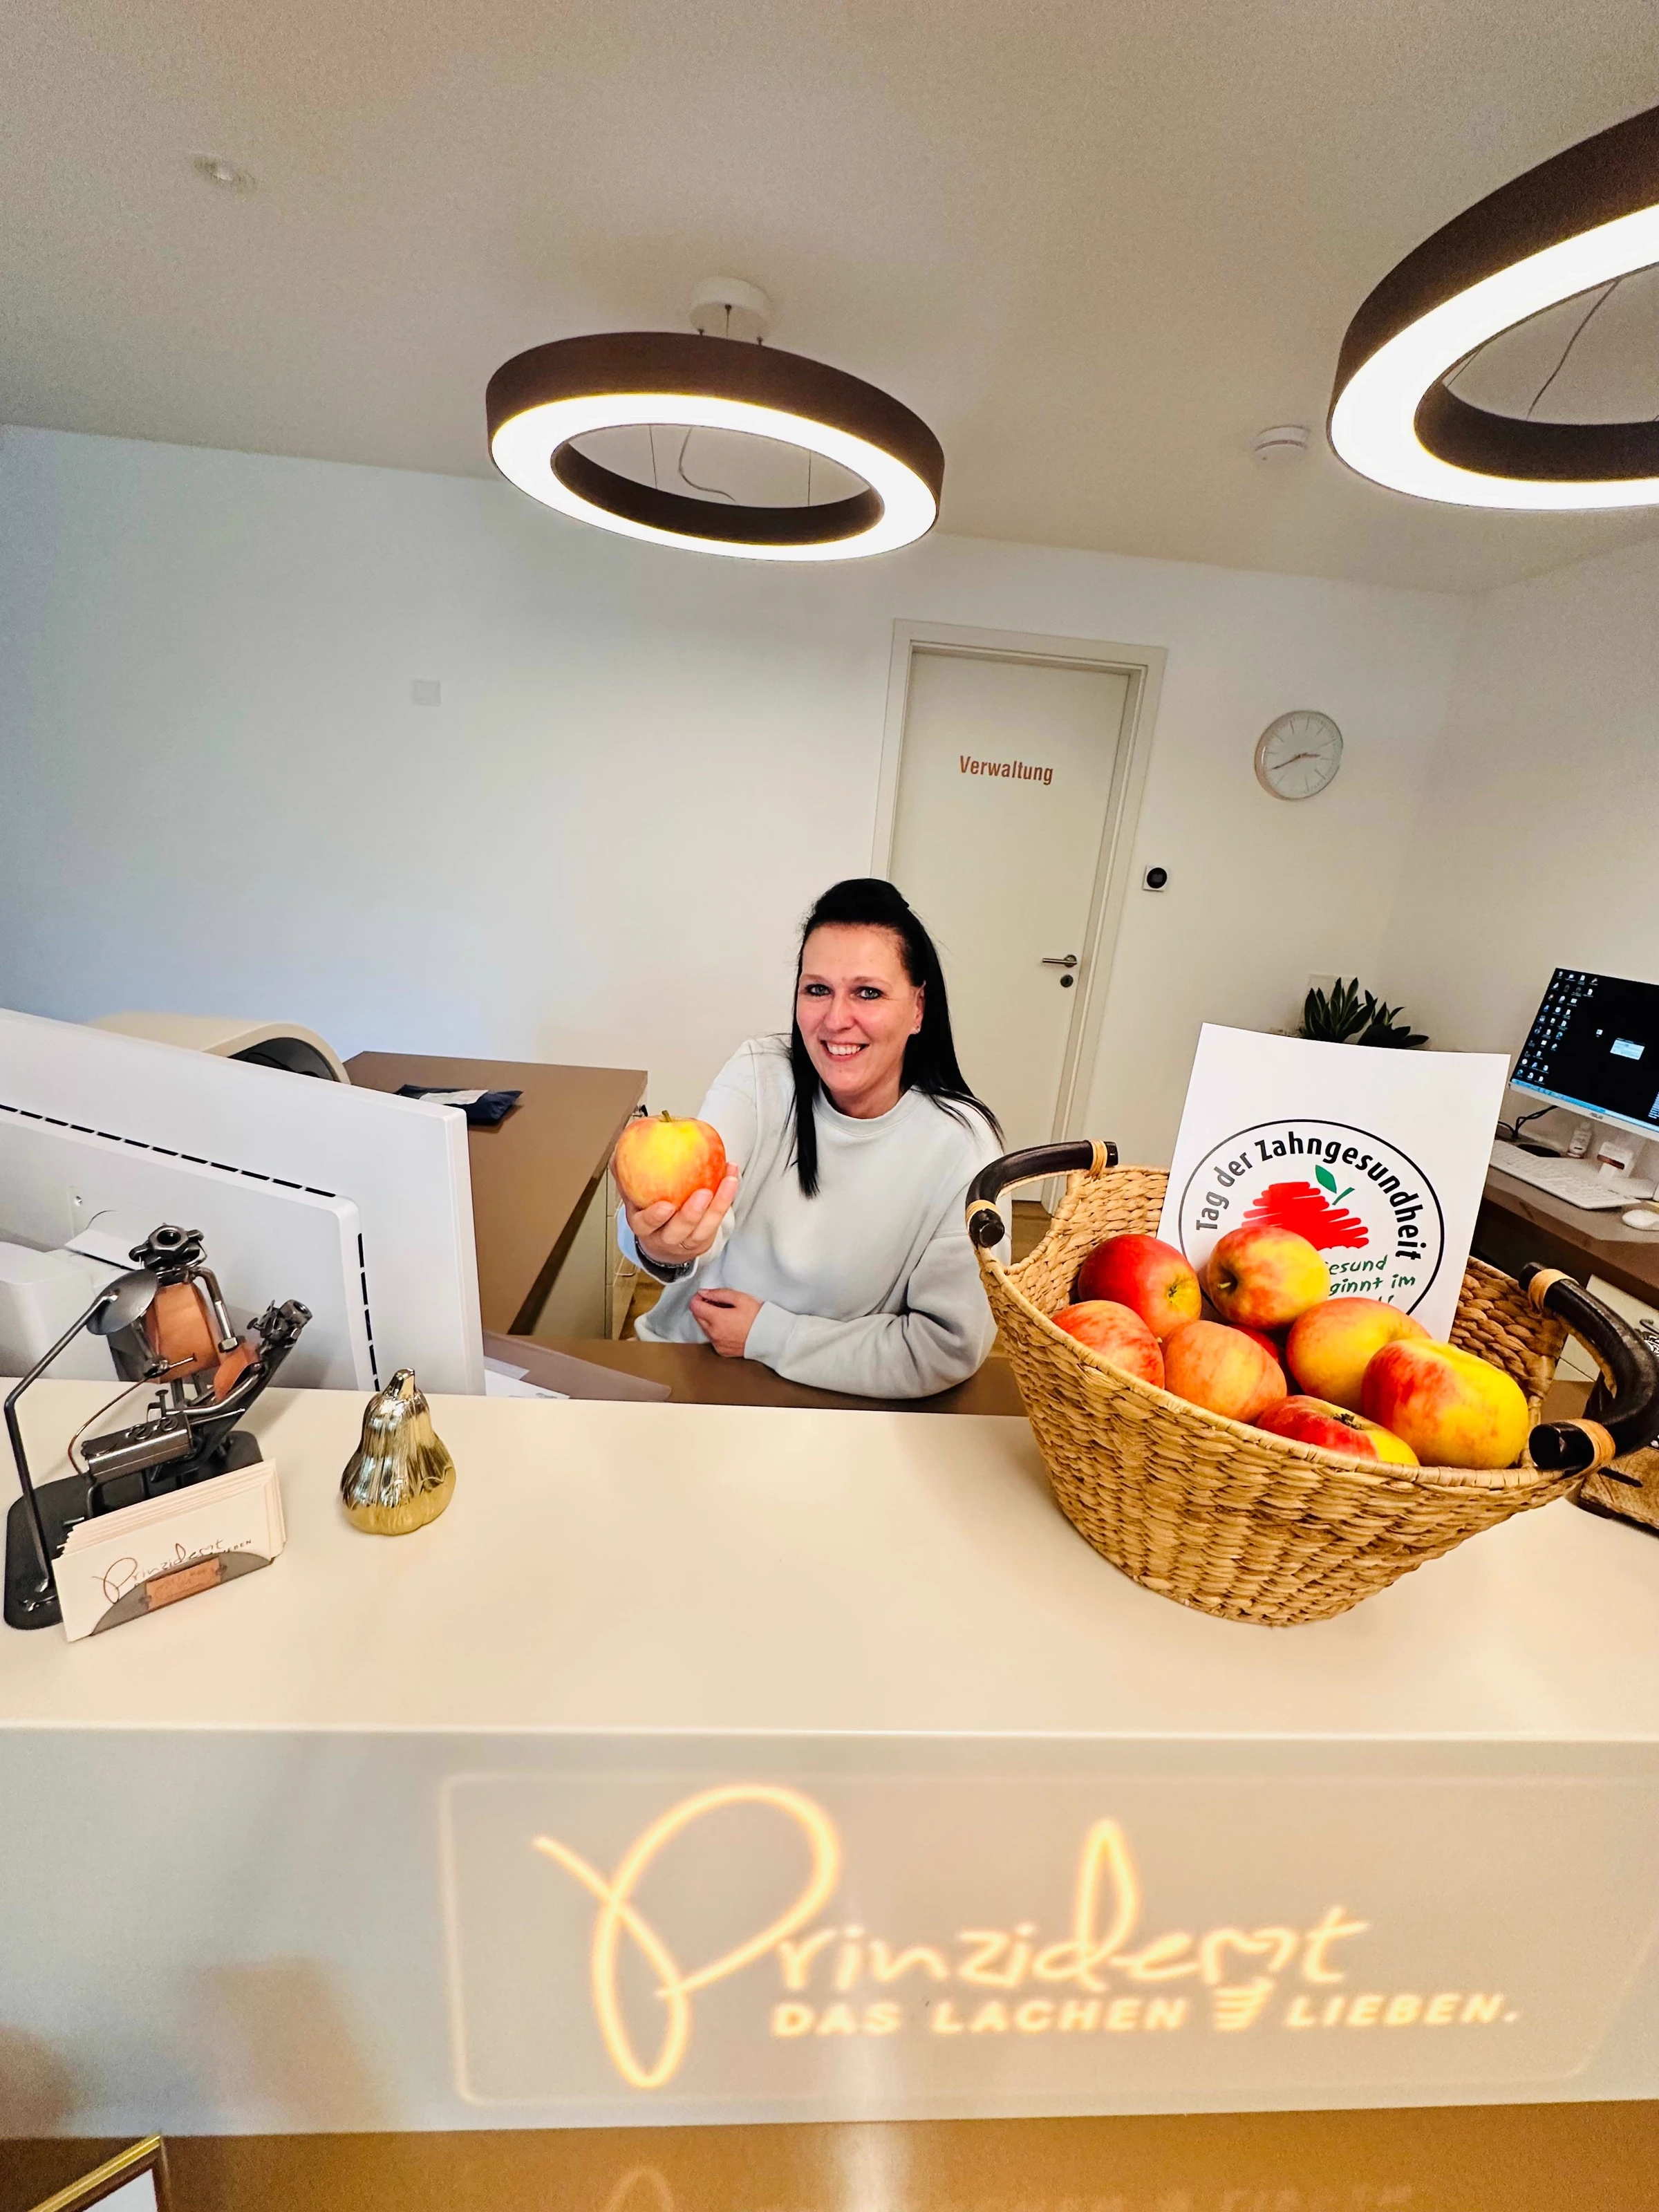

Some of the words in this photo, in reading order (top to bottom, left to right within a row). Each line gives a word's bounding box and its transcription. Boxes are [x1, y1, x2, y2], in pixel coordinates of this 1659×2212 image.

[959, 755, 1053, 786] Verwaltung
[1196, 1191, 1230, 1230] Tag
[1213, 1152, 1253, 1188] der
[1254, 1131, 1427, 1260] Zahngesundheit
[1325, 1254, 1388, 1275] esund
[1328, 1277, 1384, 1297] ginnt
[1391, 1273, 1416, 1289] im
[771, 2000, 903, 2038] DAS
[930, 1998, 1188, 2034] LACHEN
[1285, 1991, 1519, 2028] LIEBEN.
